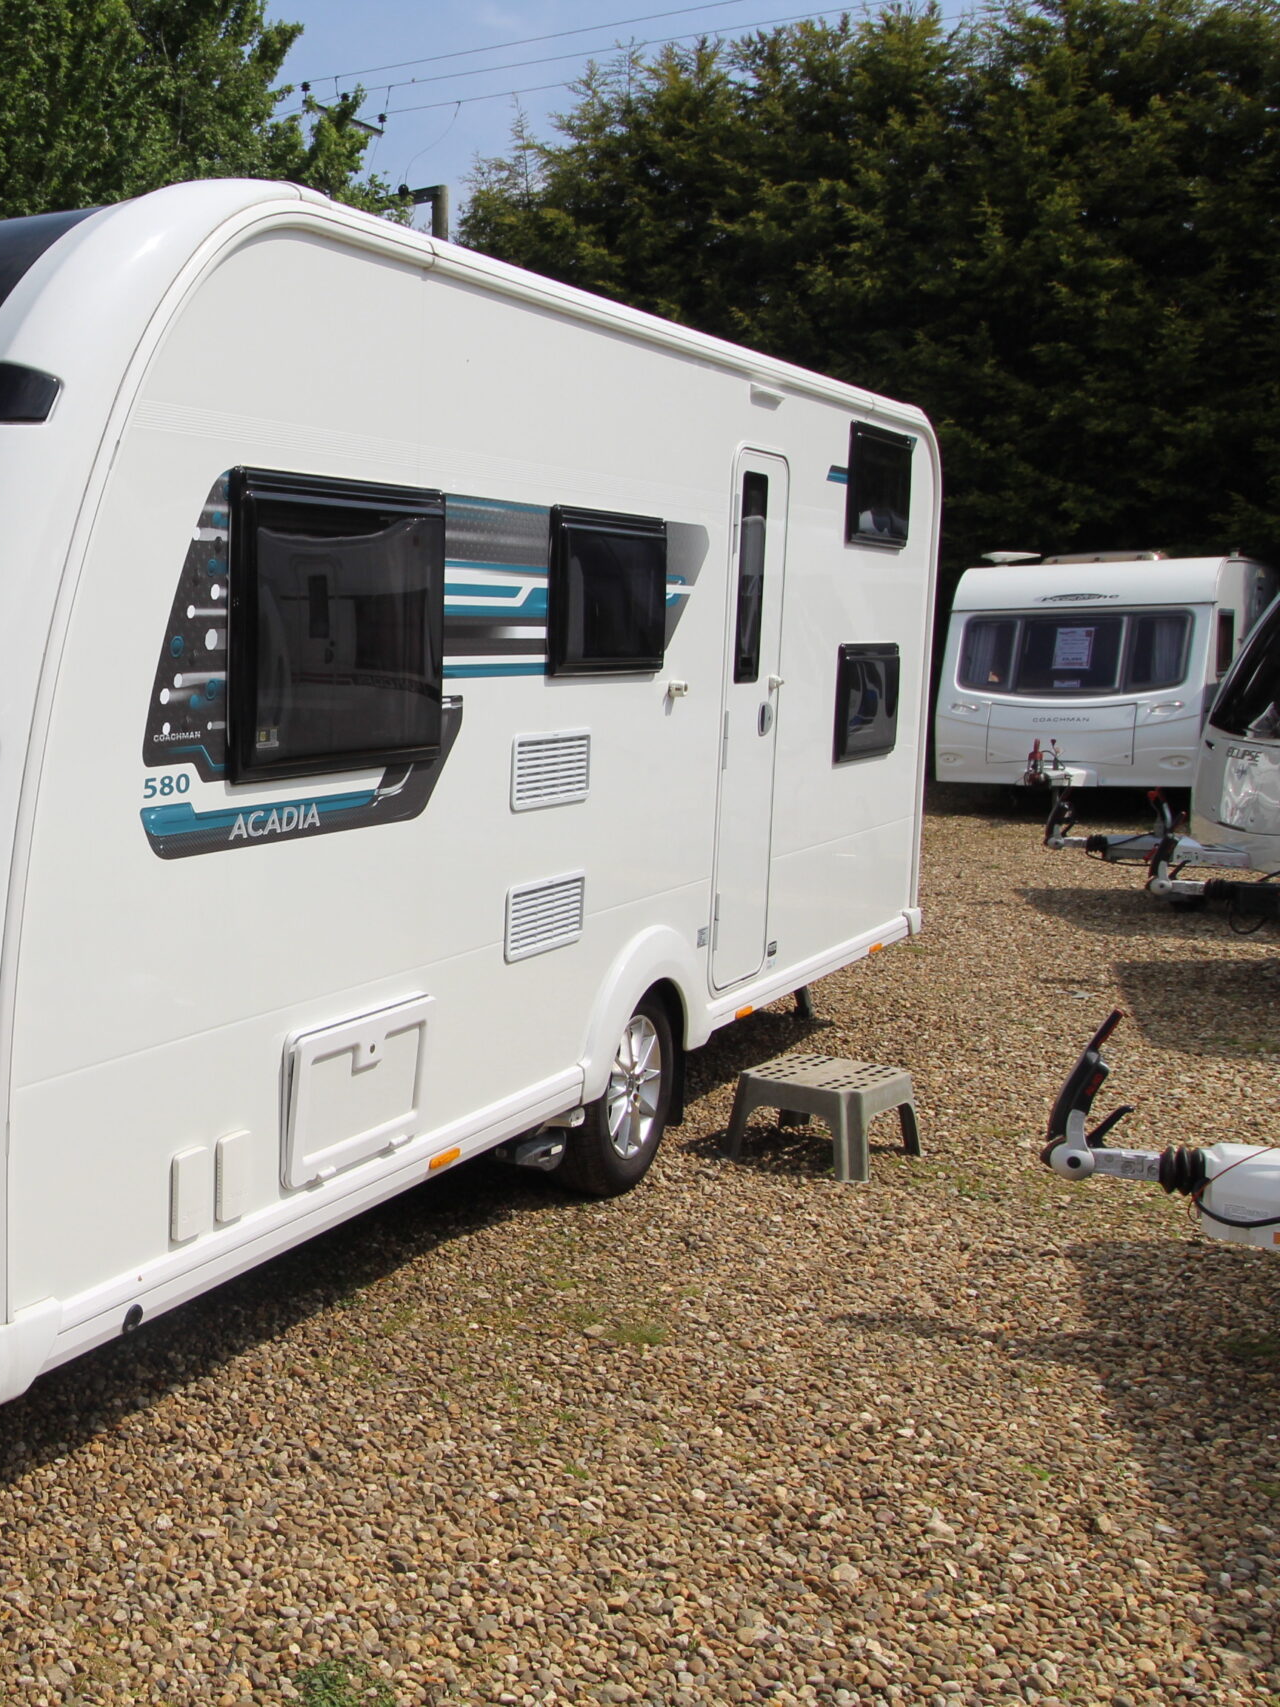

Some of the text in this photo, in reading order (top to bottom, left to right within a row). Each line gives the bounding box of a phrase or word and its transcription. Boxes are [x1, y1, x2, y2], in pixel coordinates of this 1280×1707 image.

[153, 730, 201, 742] COACHMAN
[1226, 746, 1263, 763] ECLIPSE
[142, 773, 191, 799] 580
[228, 802, 321, 841] ACADIA
